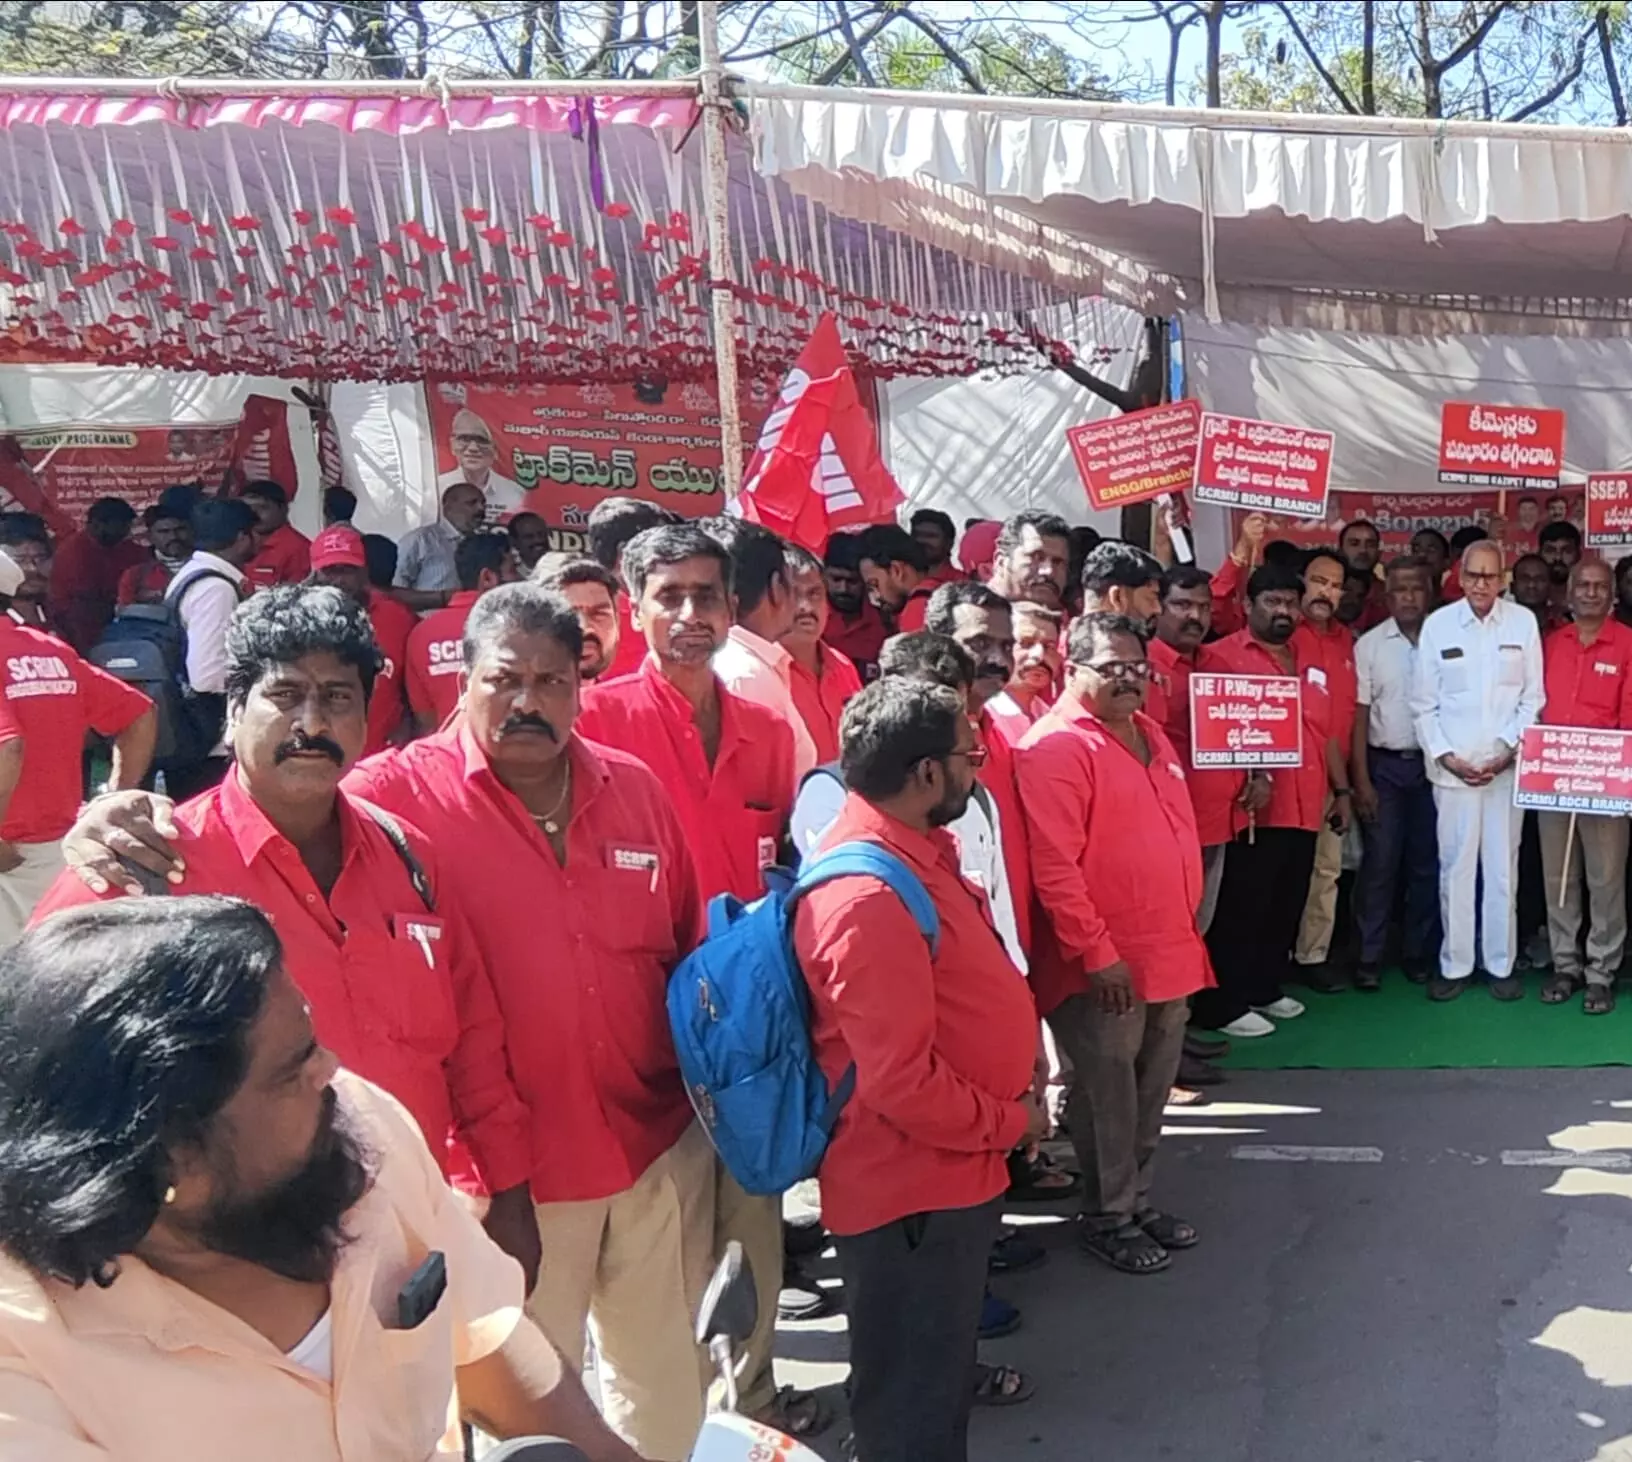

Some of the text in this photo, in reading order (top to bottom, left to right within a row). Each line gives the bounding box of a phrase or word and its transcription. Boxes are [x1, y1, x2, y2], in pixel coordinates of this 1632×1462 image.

[1197, 486, 1322, 513] SCRMU BDCR BRANCH
[1590, 533, 1623, 544] SCRMU
[7, 655, 69, 681] SCRMU
[1195, 679, 1215, 696] JE
[1225, 679, 1263, 701] P.Way
[1197, 751, 1299, 764] SCRMU BDCR BRANCH
[1518, 793, 1556, 805] SCRMU
[1558, 796, 1590, 808] BDCR
